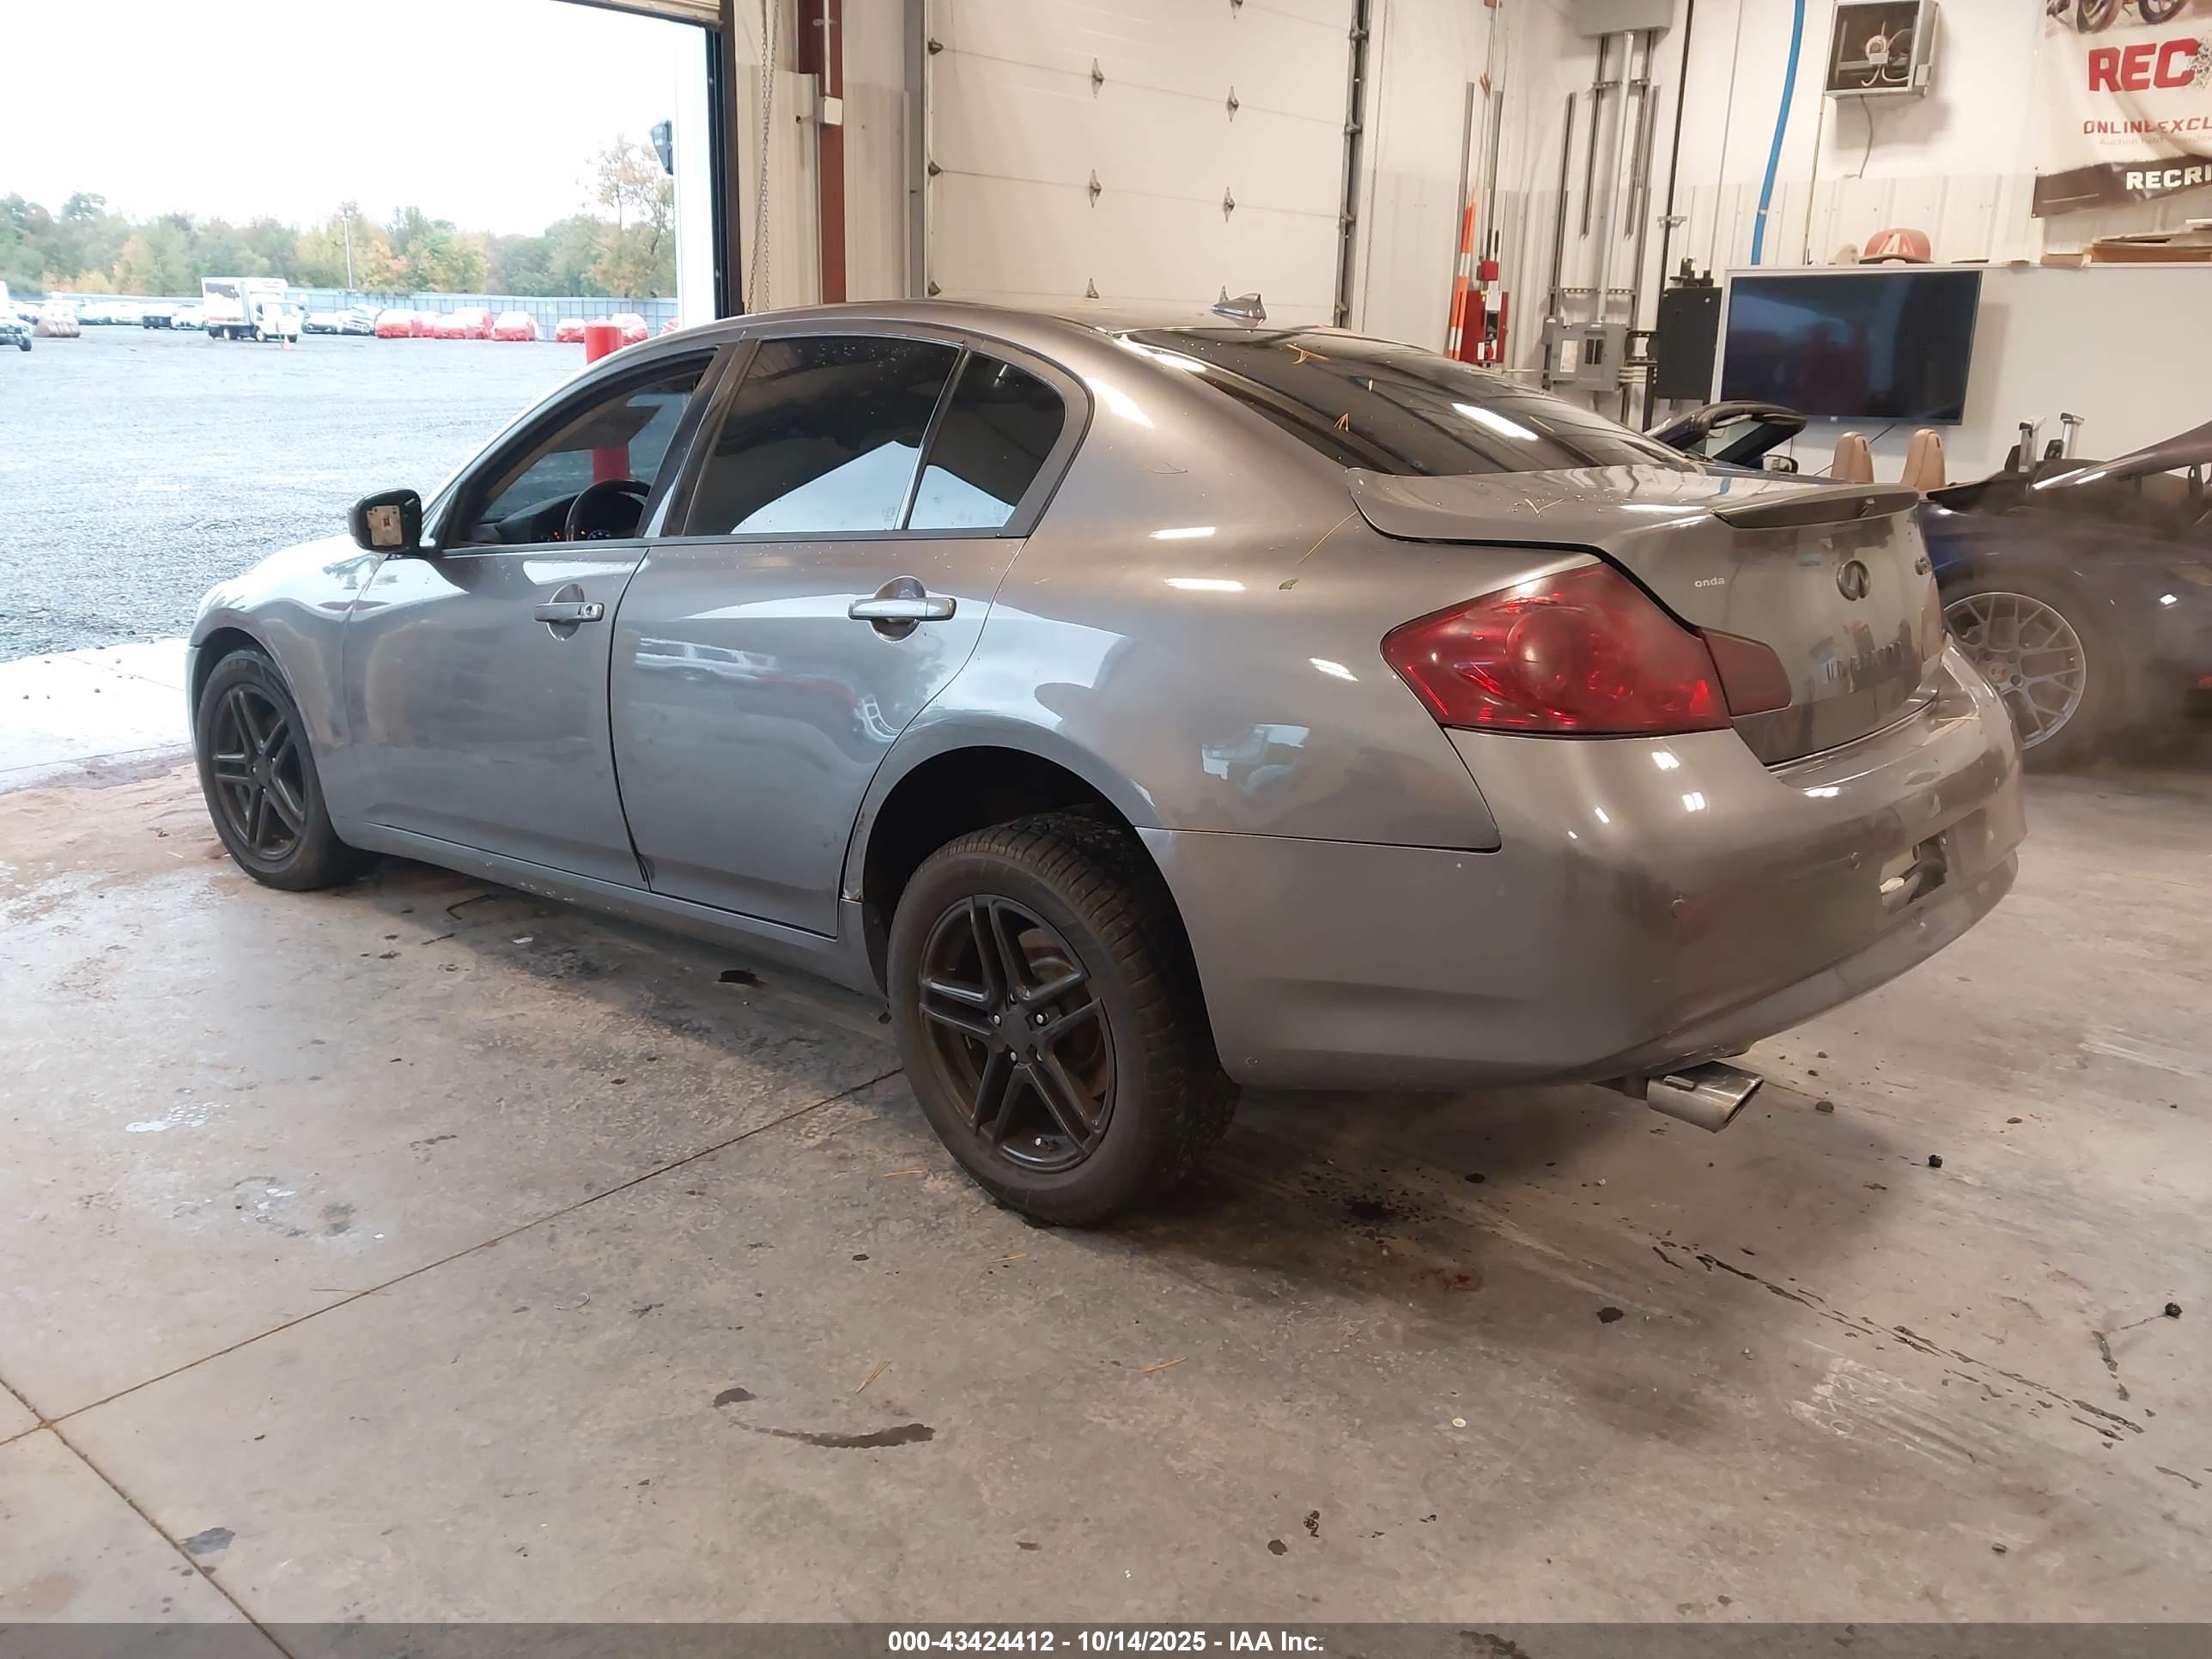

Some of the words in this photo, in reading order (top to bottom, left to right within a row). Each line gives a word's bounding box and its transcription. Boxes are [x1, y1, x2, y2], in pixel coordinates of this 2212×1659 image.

[2088, 38, 2202, 92] REC
[2083, 119, 2154, 134] ONLINE
[2157, 116, 2212, 133] EXCL
[2126, 164, 2212, 190] RECRI
[1694, 576, 1725, 587] onda
